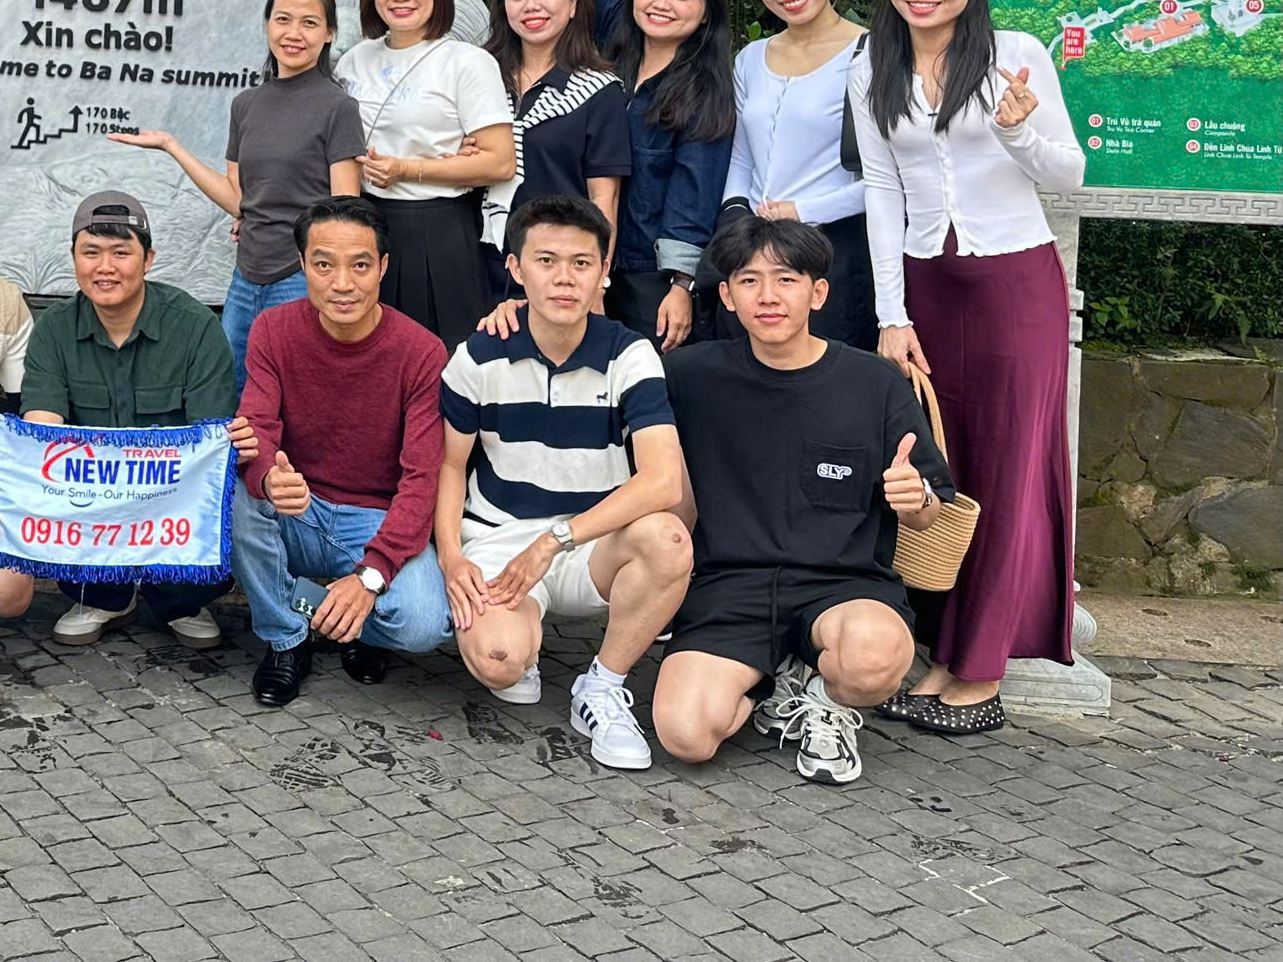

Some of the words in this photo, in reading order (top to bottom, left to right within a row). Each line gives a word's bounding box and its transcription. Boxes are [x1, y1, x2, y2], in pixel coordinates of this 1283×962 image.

[1164, 2, 1175, 12] 01
[1248, 0, 1259, 10] 05
[20, 21, 74, 48] Xin
[85, 22, 174, 52] chào!
[1067, 28, 1081, 38] You
[1066, 38, 1079, 46] are
[1066, 46, 1083, 54] here
[45, 59, 73, 79] to
[79, 61, 111, 82] Ba
[119, 64, 155, 84] Na
[86, 106, 107, 119] 170
[85, 122, 107, 134] 170
[123, 448, 181, 458] TRAVEL
[65, 458, 121, 485] NEW
[125, 460, 181, 485] TIME
[819, 465, 845, 478] SLY
[41, 484, 65, 496] Your
[127, 488, 177, 501] Happiness
[21, 517, 83, 546] 0916
[92, 524, 122, 546] 77
[128, 520, 154, 546] 12
[160, 518, 191, 546] 39
